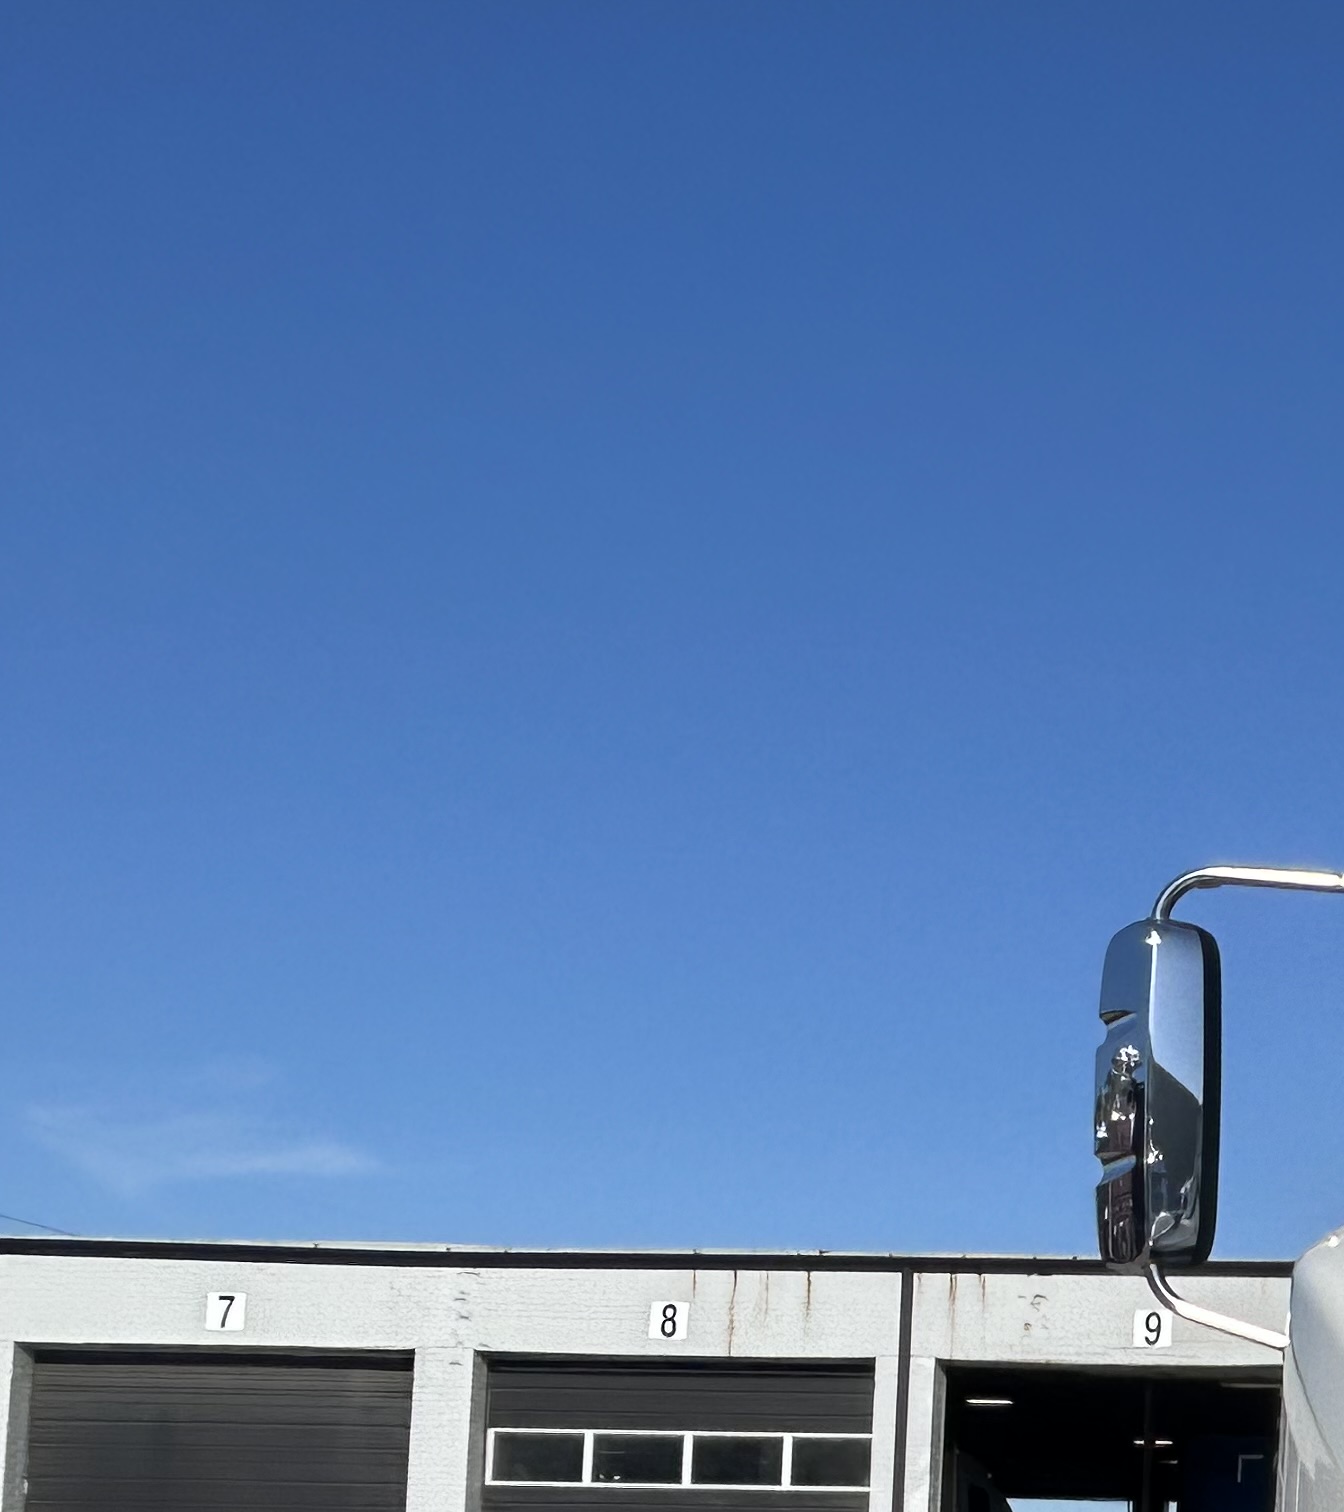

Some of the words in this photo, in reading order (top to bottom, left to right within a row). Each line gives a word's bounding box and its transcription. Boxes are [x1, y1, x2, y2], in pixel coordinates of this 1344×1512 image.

[218, 1295, 235, 1329] 7
[660, 1303, 677, 1338] 8
[1144, 1311, 1162, 1346] 9
